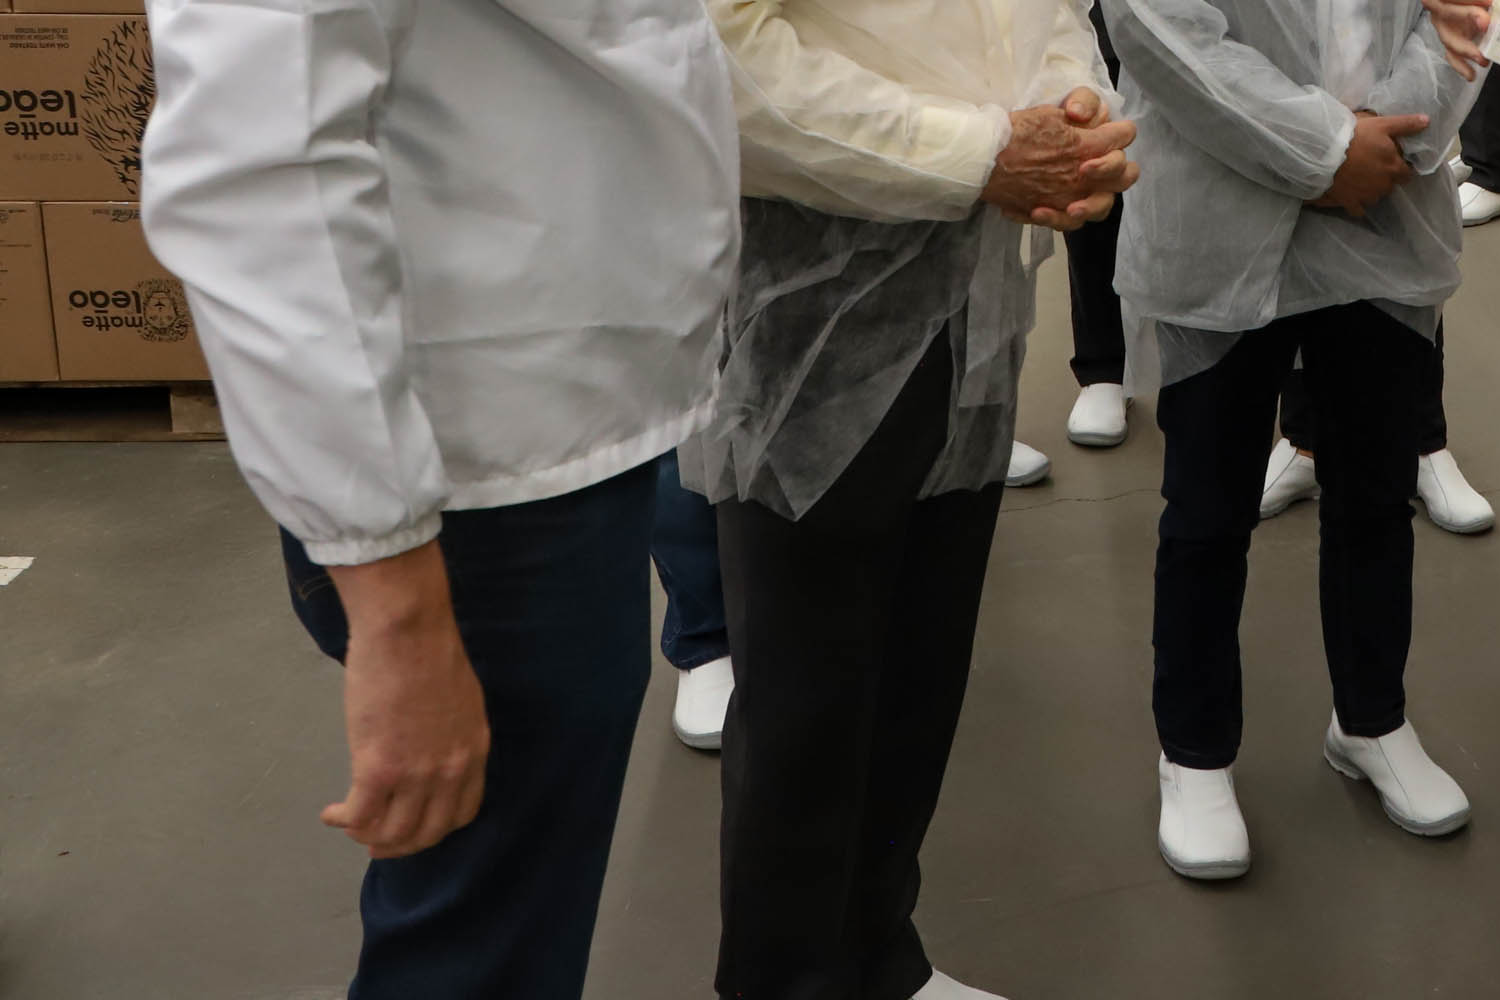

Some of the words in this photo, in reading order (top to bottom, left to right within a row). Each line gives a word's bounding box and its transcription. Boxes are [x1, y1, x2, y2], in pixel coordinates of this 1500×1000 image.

[3, 121, 79, 140] matte
[68, 290, 142, 314] leão
[82, 316, 144, 332] matte
